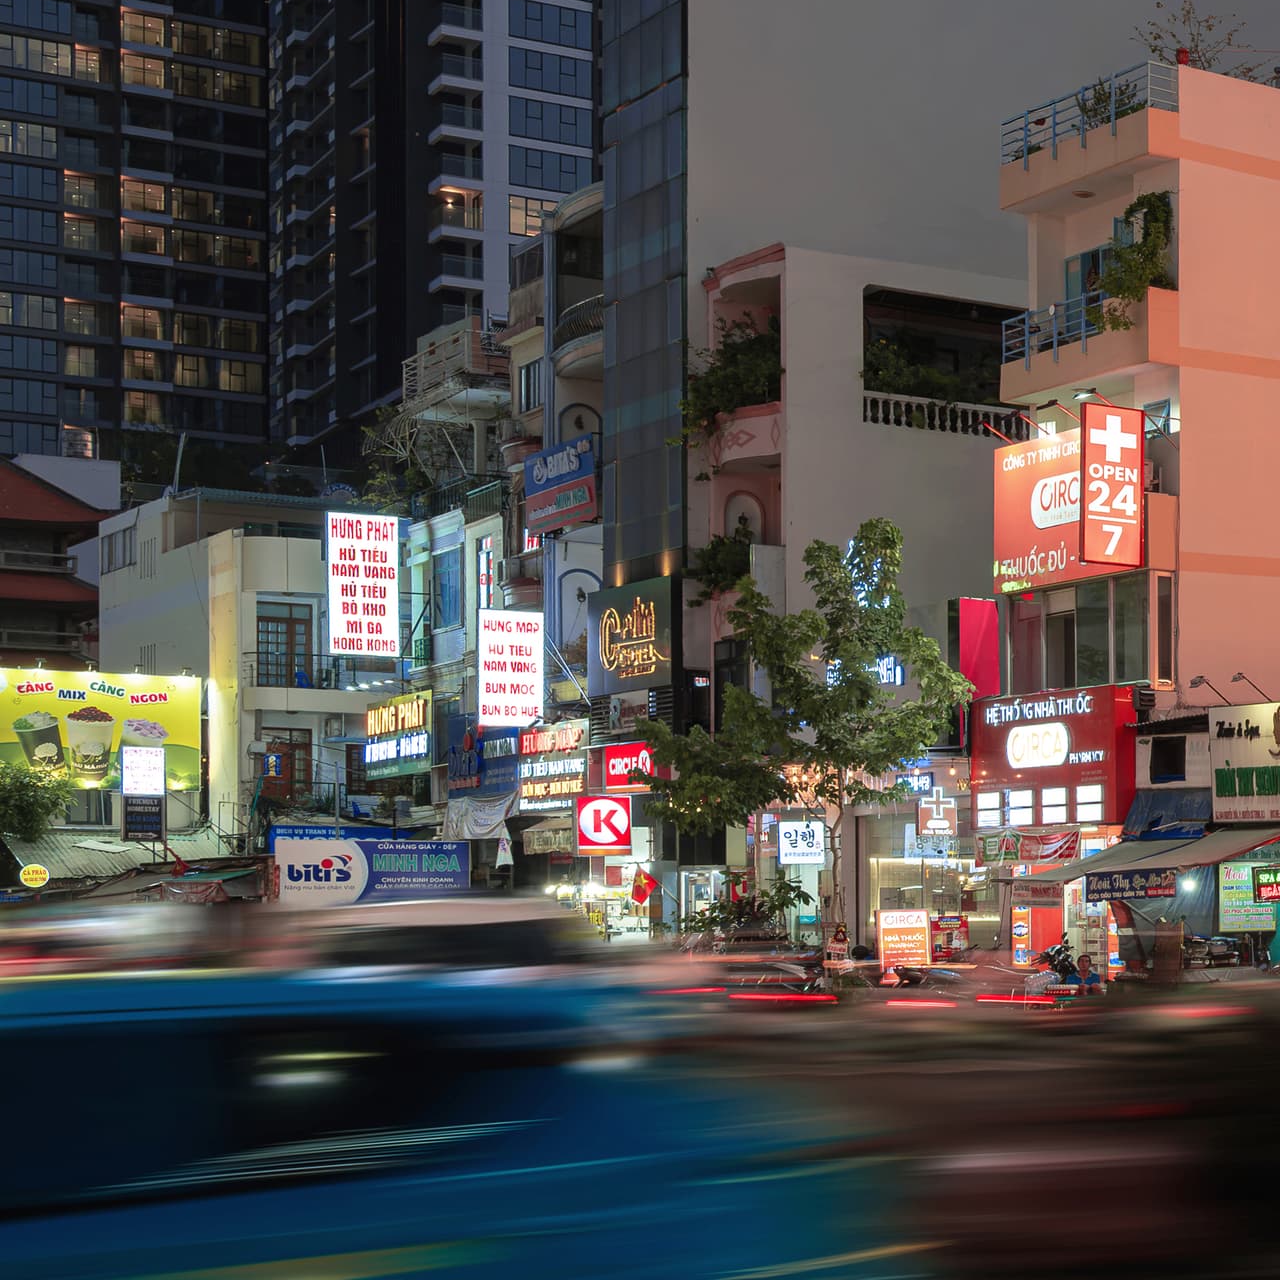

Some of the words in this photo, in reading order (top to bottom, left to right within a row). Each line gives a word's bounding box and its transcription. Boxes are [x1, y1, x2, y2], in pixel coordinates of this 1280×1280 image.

[1026, 450, 1037, 466] TY
[1038, 446, 1061, 464] TNHH
[1088, 463, 1138, 483] OPEN
[1088, 480, 1138, 517] 24
[1102, 524, 1123, 556] 7
[332, 563, 359, 578] NAM
[364, 565, 395, 580] VANG
[362, 603, 386, 616] KHO
[484, 660, 507, 672] NAM
[511, 661, 537, 673] VANG
[17, 681, 54, 693] CÀNG
[58, 689, 86, 701] MIX
[90, 680, 125, 697] CÀNG
[130, 692, 168, 704] NGON
[1034, 696, 1056, 719] NHÀ
[1011, 729, 1062, 763] CIRCA
[593, 808, 625, 840] K
[783, 829, 816, 849] 일행
[373, 854, 418, 872] MINH
[422, 853, 461, 872] NGA
[1259, 873, 1275, 883] SPA
[884, 914, 923, 925] CIRCA
